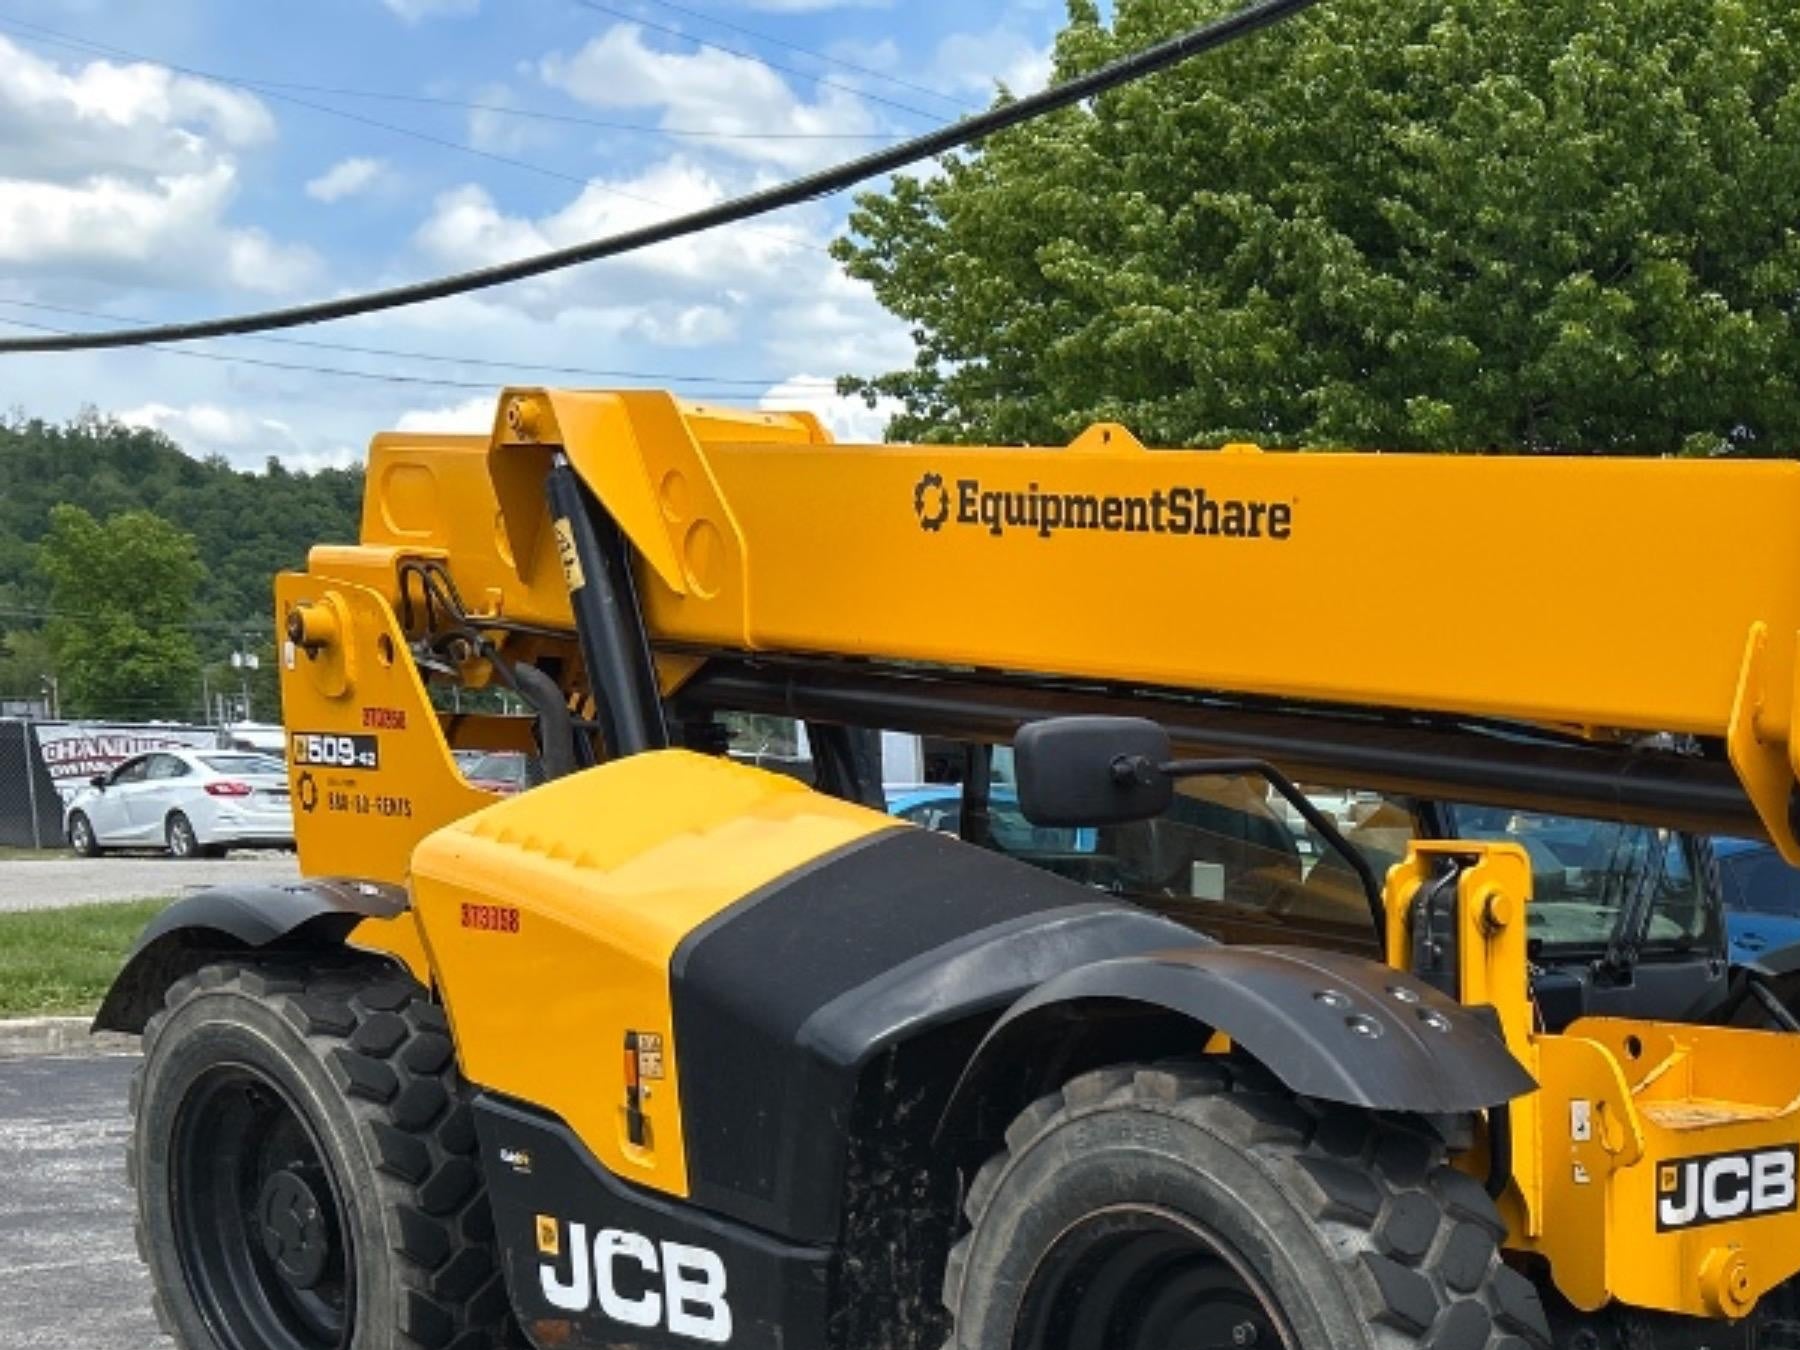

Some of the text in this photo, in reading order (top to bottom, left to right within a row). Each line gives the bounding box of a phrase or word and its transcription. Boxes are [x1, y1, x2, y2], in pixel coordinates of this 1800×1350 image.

[956, 480, 1292, 539] EquipmentShare
[1660, 1150, 1796, 1226] JCB
[539, 1220, 733, 1343] JCB
